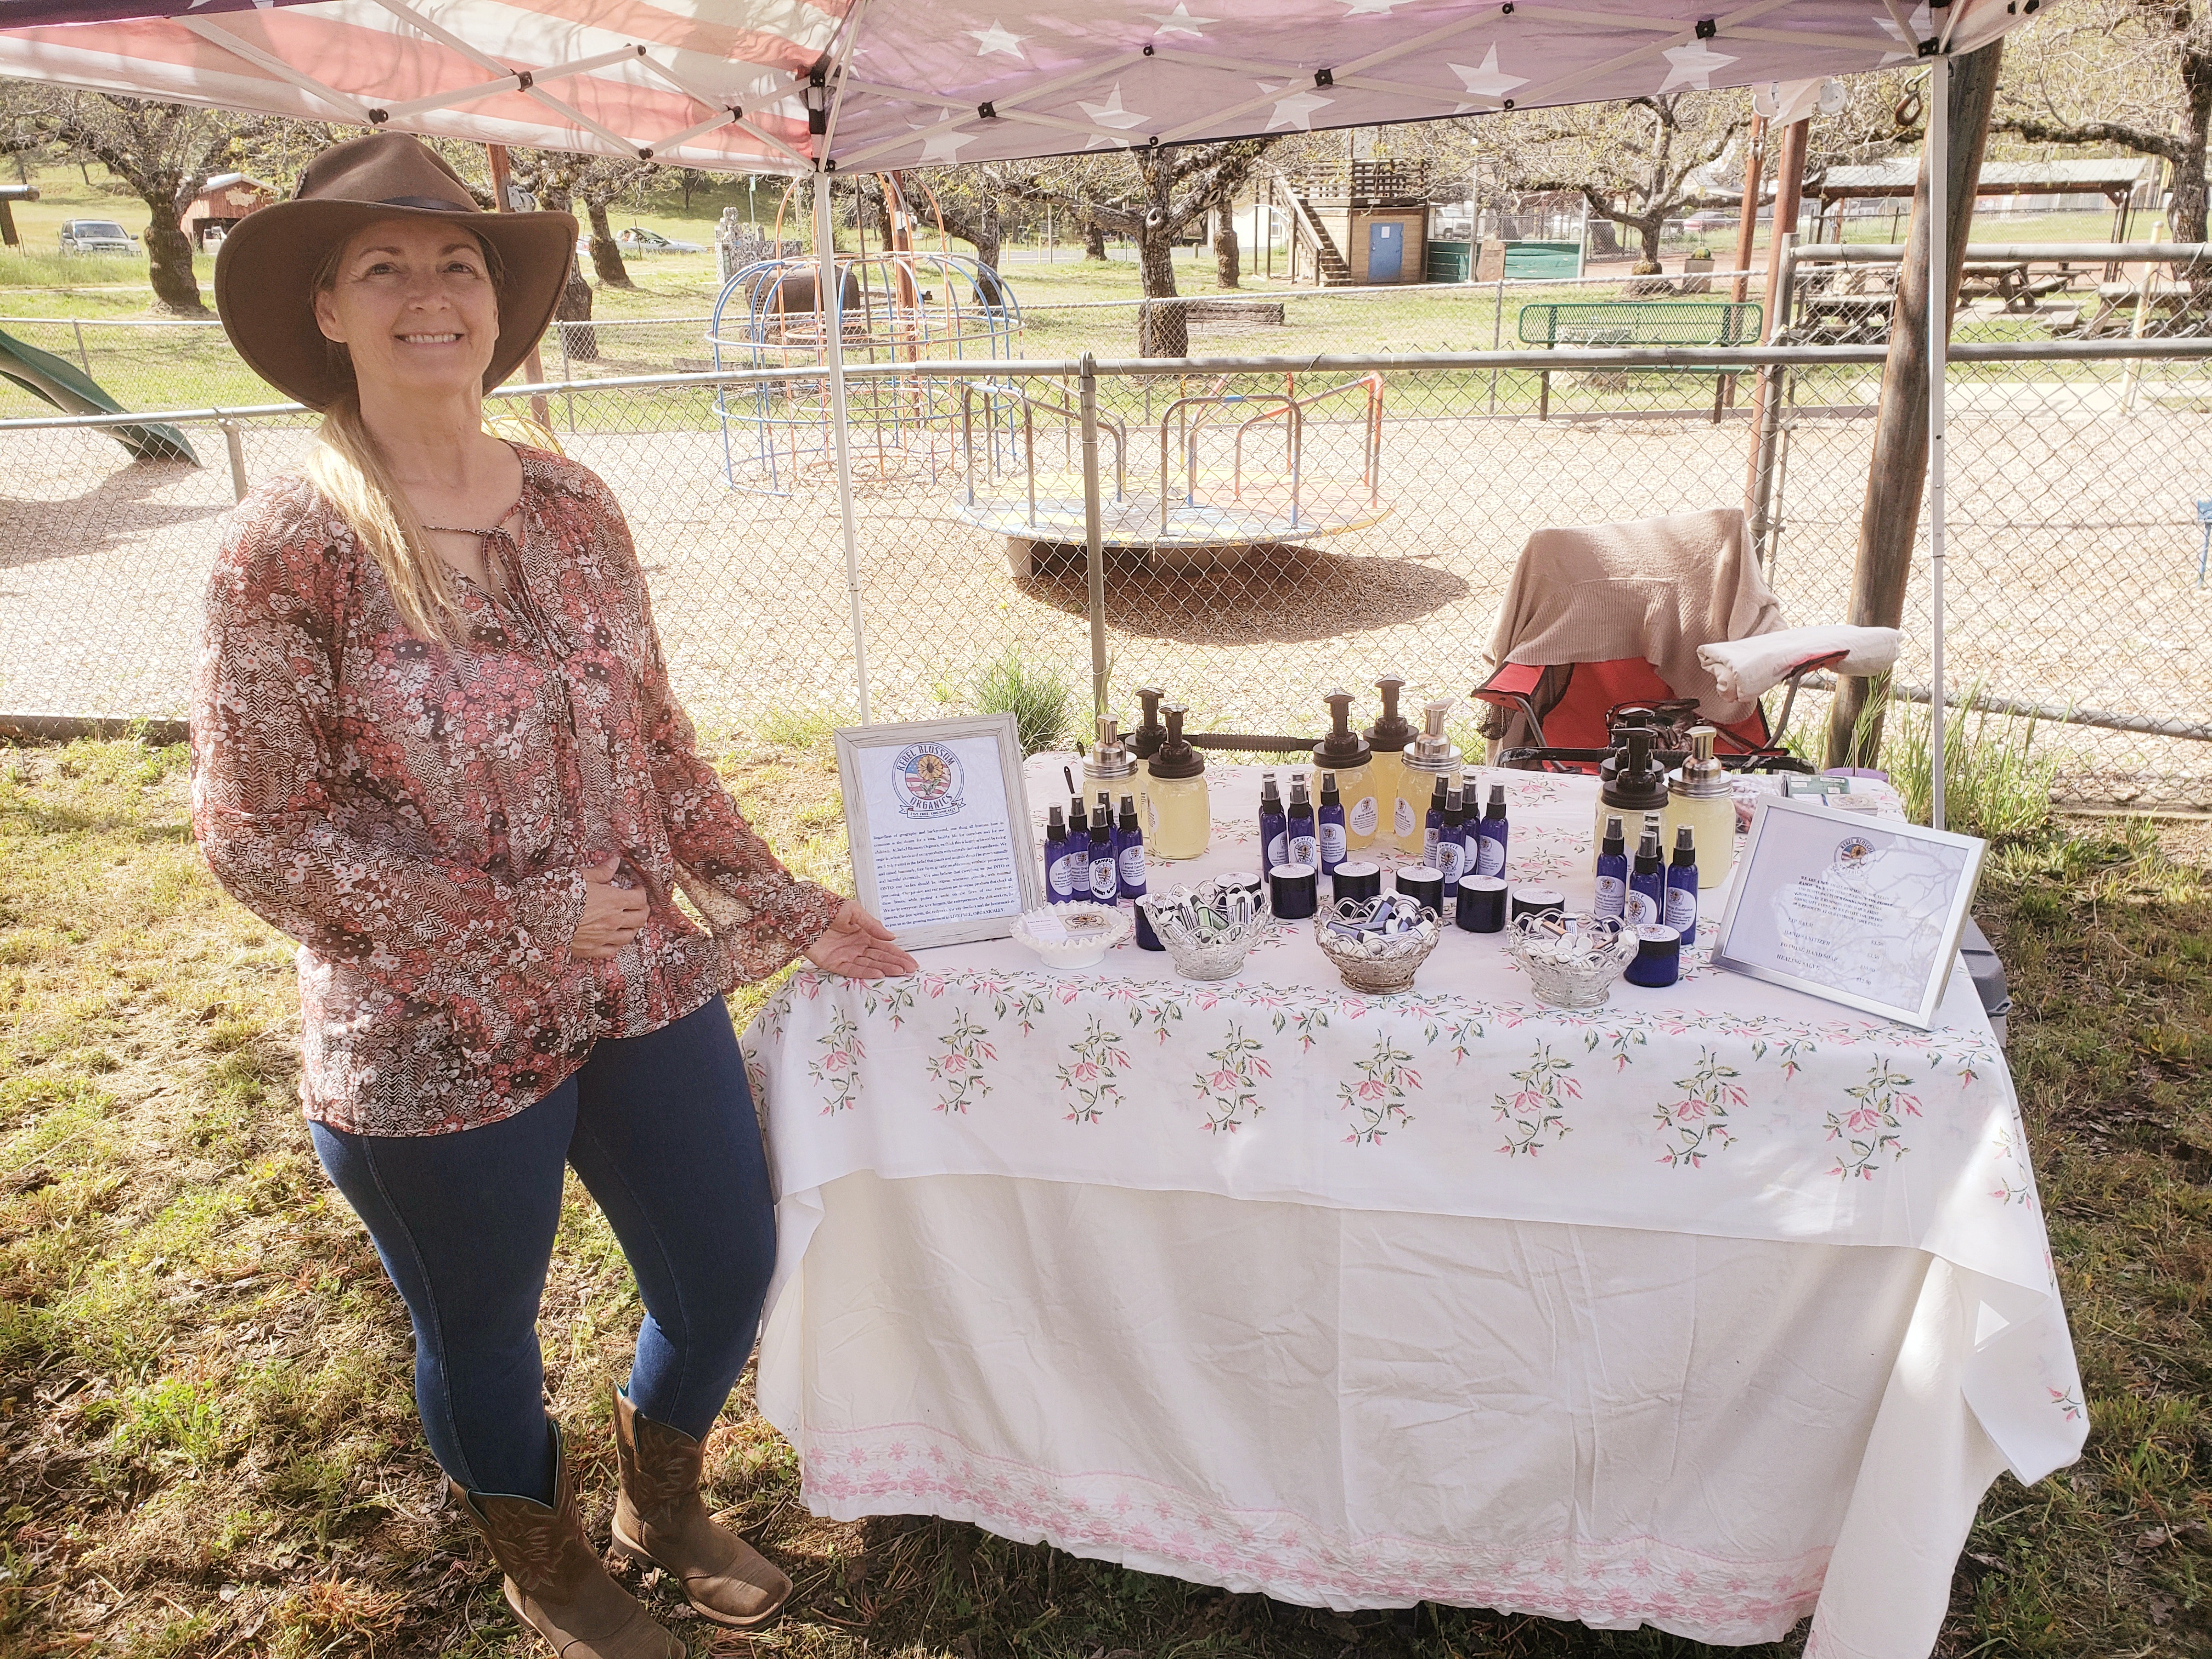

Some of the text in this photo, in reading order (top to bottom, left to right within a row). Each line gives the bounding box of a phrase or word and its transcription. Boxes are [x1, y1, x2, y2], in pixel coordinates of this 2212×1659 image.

[897, 746, 955, 771] REBEL BLOSSOM
[911, 793, 953, 809] ORGANICS
[1780, 943, 1804, 952] FOAMING
[1801, 935, 1830, 945] SANITIZER
[1776, 955, 1819, 970] HEALING SALVE
